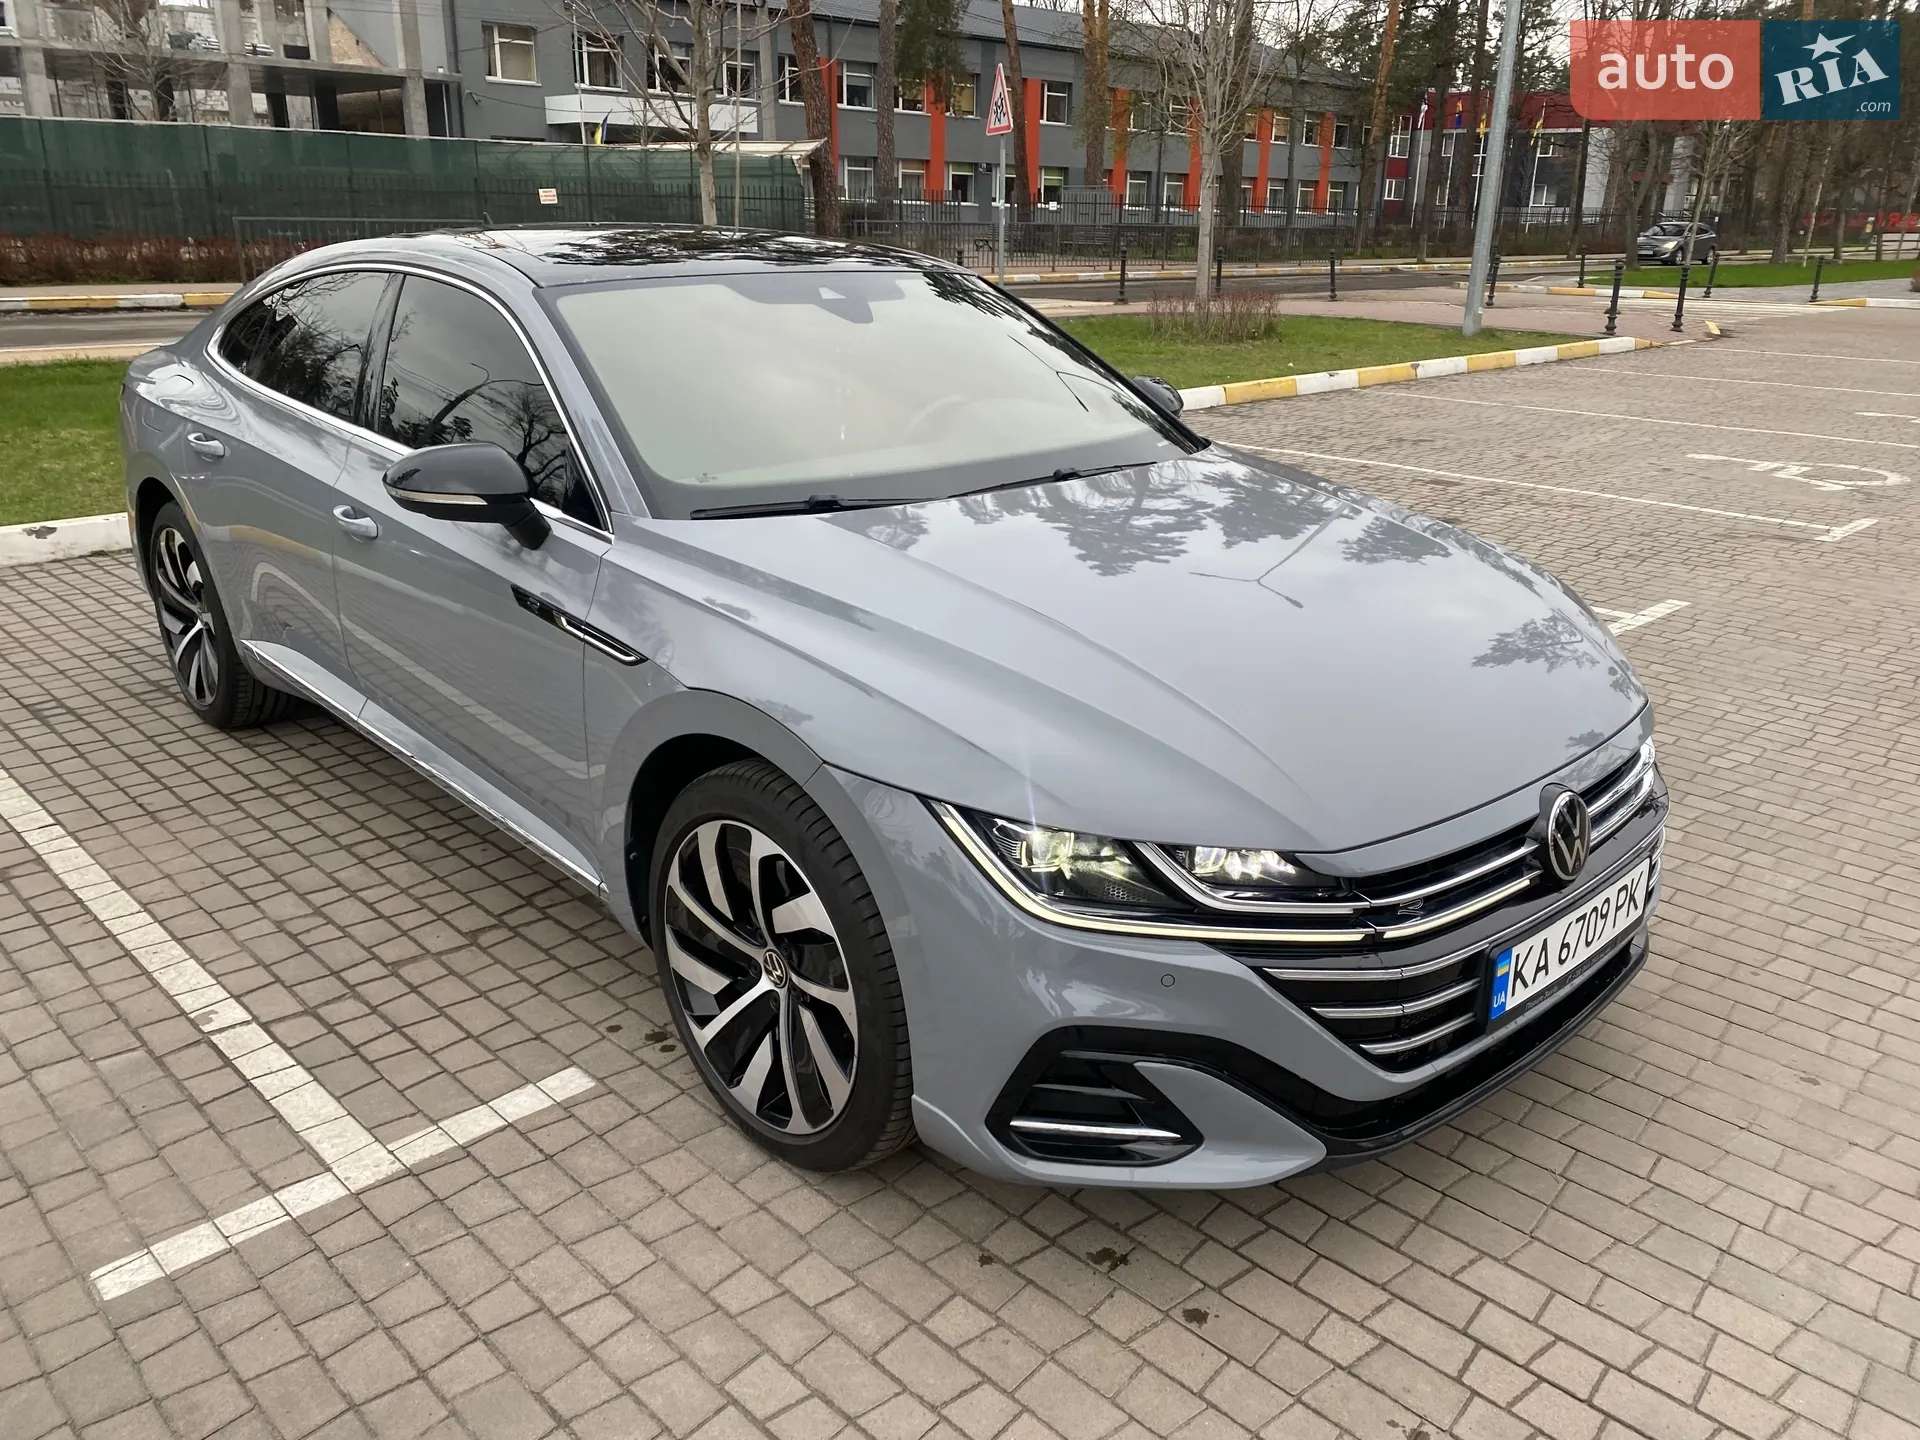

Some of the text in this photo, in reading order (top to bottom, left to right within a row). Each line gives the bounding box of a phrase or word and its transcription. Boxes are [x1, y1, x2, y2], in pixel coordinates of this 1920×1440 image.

[1511, 937, 1550, 998] KA
[1558, 896, 1611, 966] 6709
[1612, 870, 1645, 929] PK
[1493, 991, 1507, 1008] UA
